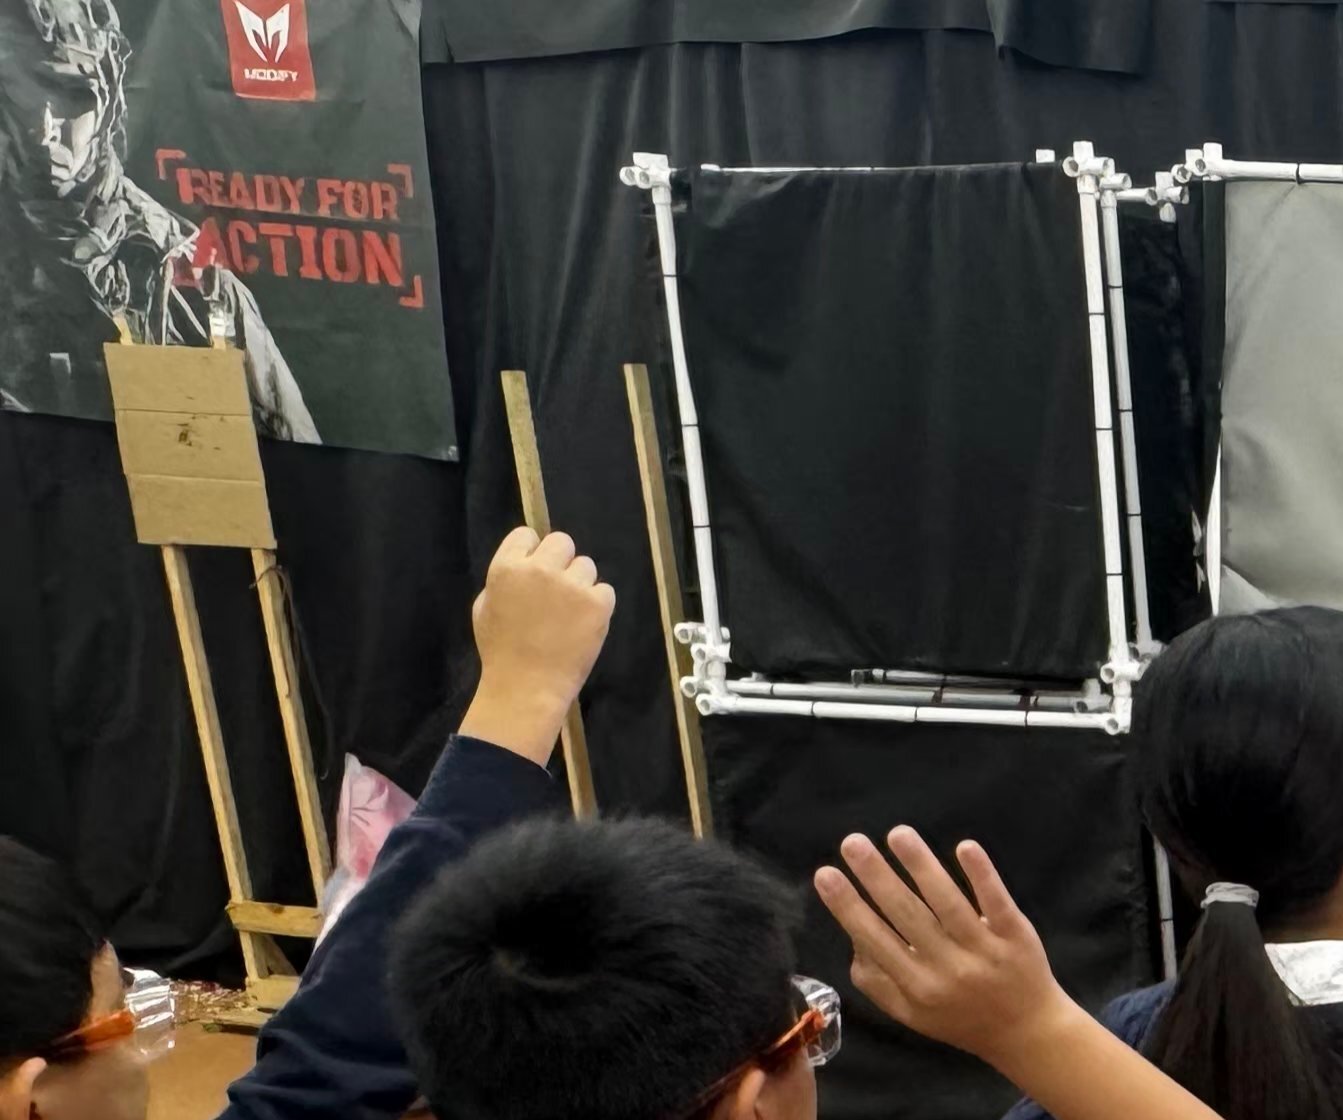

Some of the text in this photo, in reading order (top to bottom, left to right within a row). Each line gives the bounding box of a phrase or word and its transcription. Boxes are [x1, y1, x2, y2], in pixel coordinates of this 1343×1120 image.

[176, 168, 399, 221] READY FOR
[173, 217, 404, 287] ACTION
